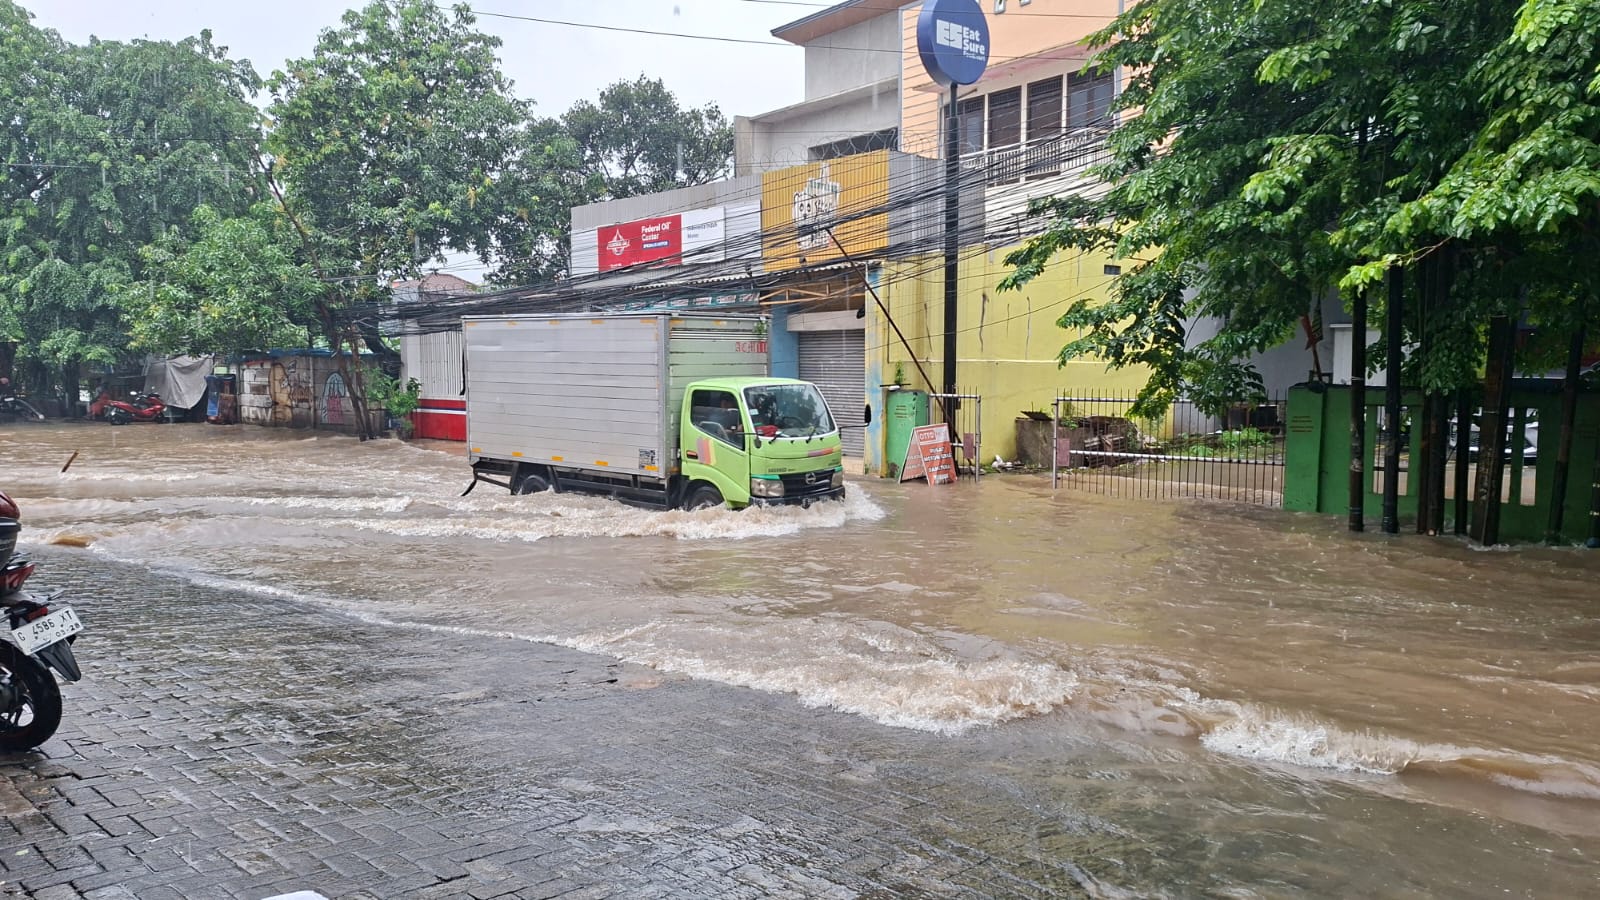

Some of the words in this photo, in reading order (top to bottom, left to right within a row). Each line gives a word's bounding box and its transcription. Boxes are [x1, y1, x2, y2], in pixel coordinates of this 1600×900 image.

[963, 26, 980, 42] Eat
[963, 39, 985, 55] Sure
[641, 223, 661, 234] Federal
[17, 631, 26, 642] G
[32, 618, 55, 635] 4586
[59, 610, 73, 623] XT
